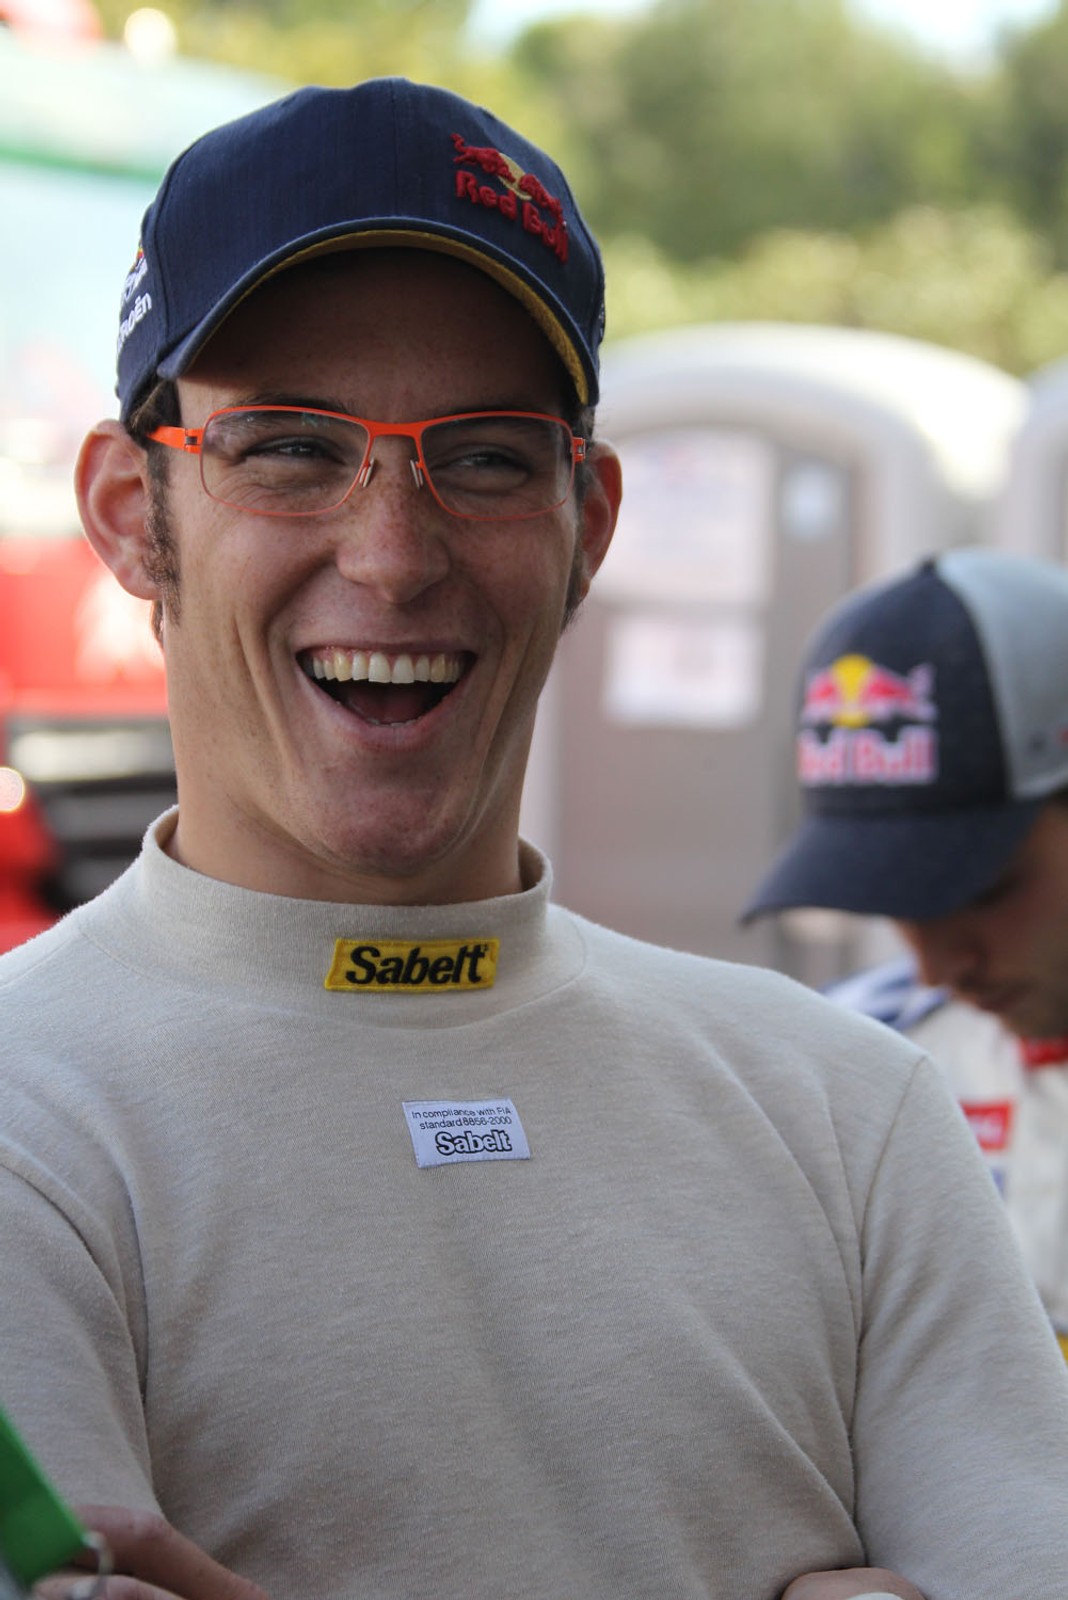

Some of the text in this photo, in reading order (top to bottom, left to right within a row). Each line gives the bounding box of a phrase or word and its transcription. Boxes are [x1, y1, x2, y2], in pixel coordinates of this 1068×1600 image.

[456, 170, 568, 264] Red Bull
[851, 725, 938, 785] Bull
[345, 944, 486, 985] Sabelt
[411, 1106, 512, 1119] In compliance with FIA
[419, 1117, 462, 1130] standard
[434, 1129, 513, 1156] Sabelt
